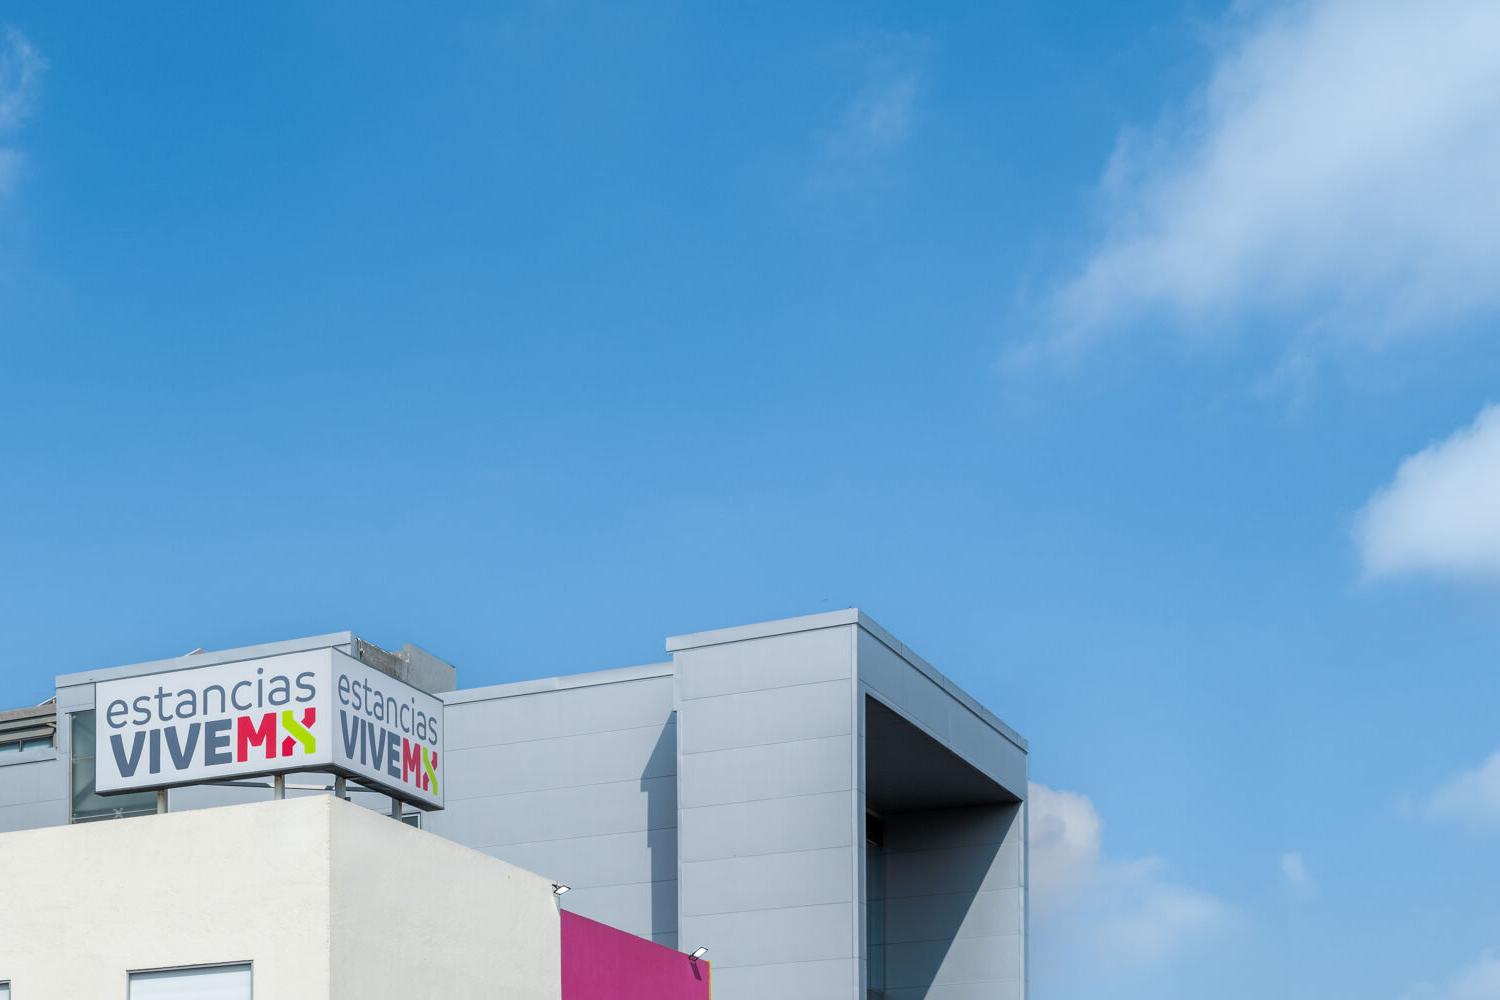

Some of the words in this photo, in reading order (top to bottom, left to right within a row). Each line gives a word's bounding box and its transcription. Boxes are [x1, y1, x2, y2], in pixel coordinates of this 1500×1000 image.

[106, 667, 316, 729] estancias
[338, 674, 438, 746] estancias
[109, 706, 316, 778] VIVEMX
[339, 709, 439, 796] VIVEMX
